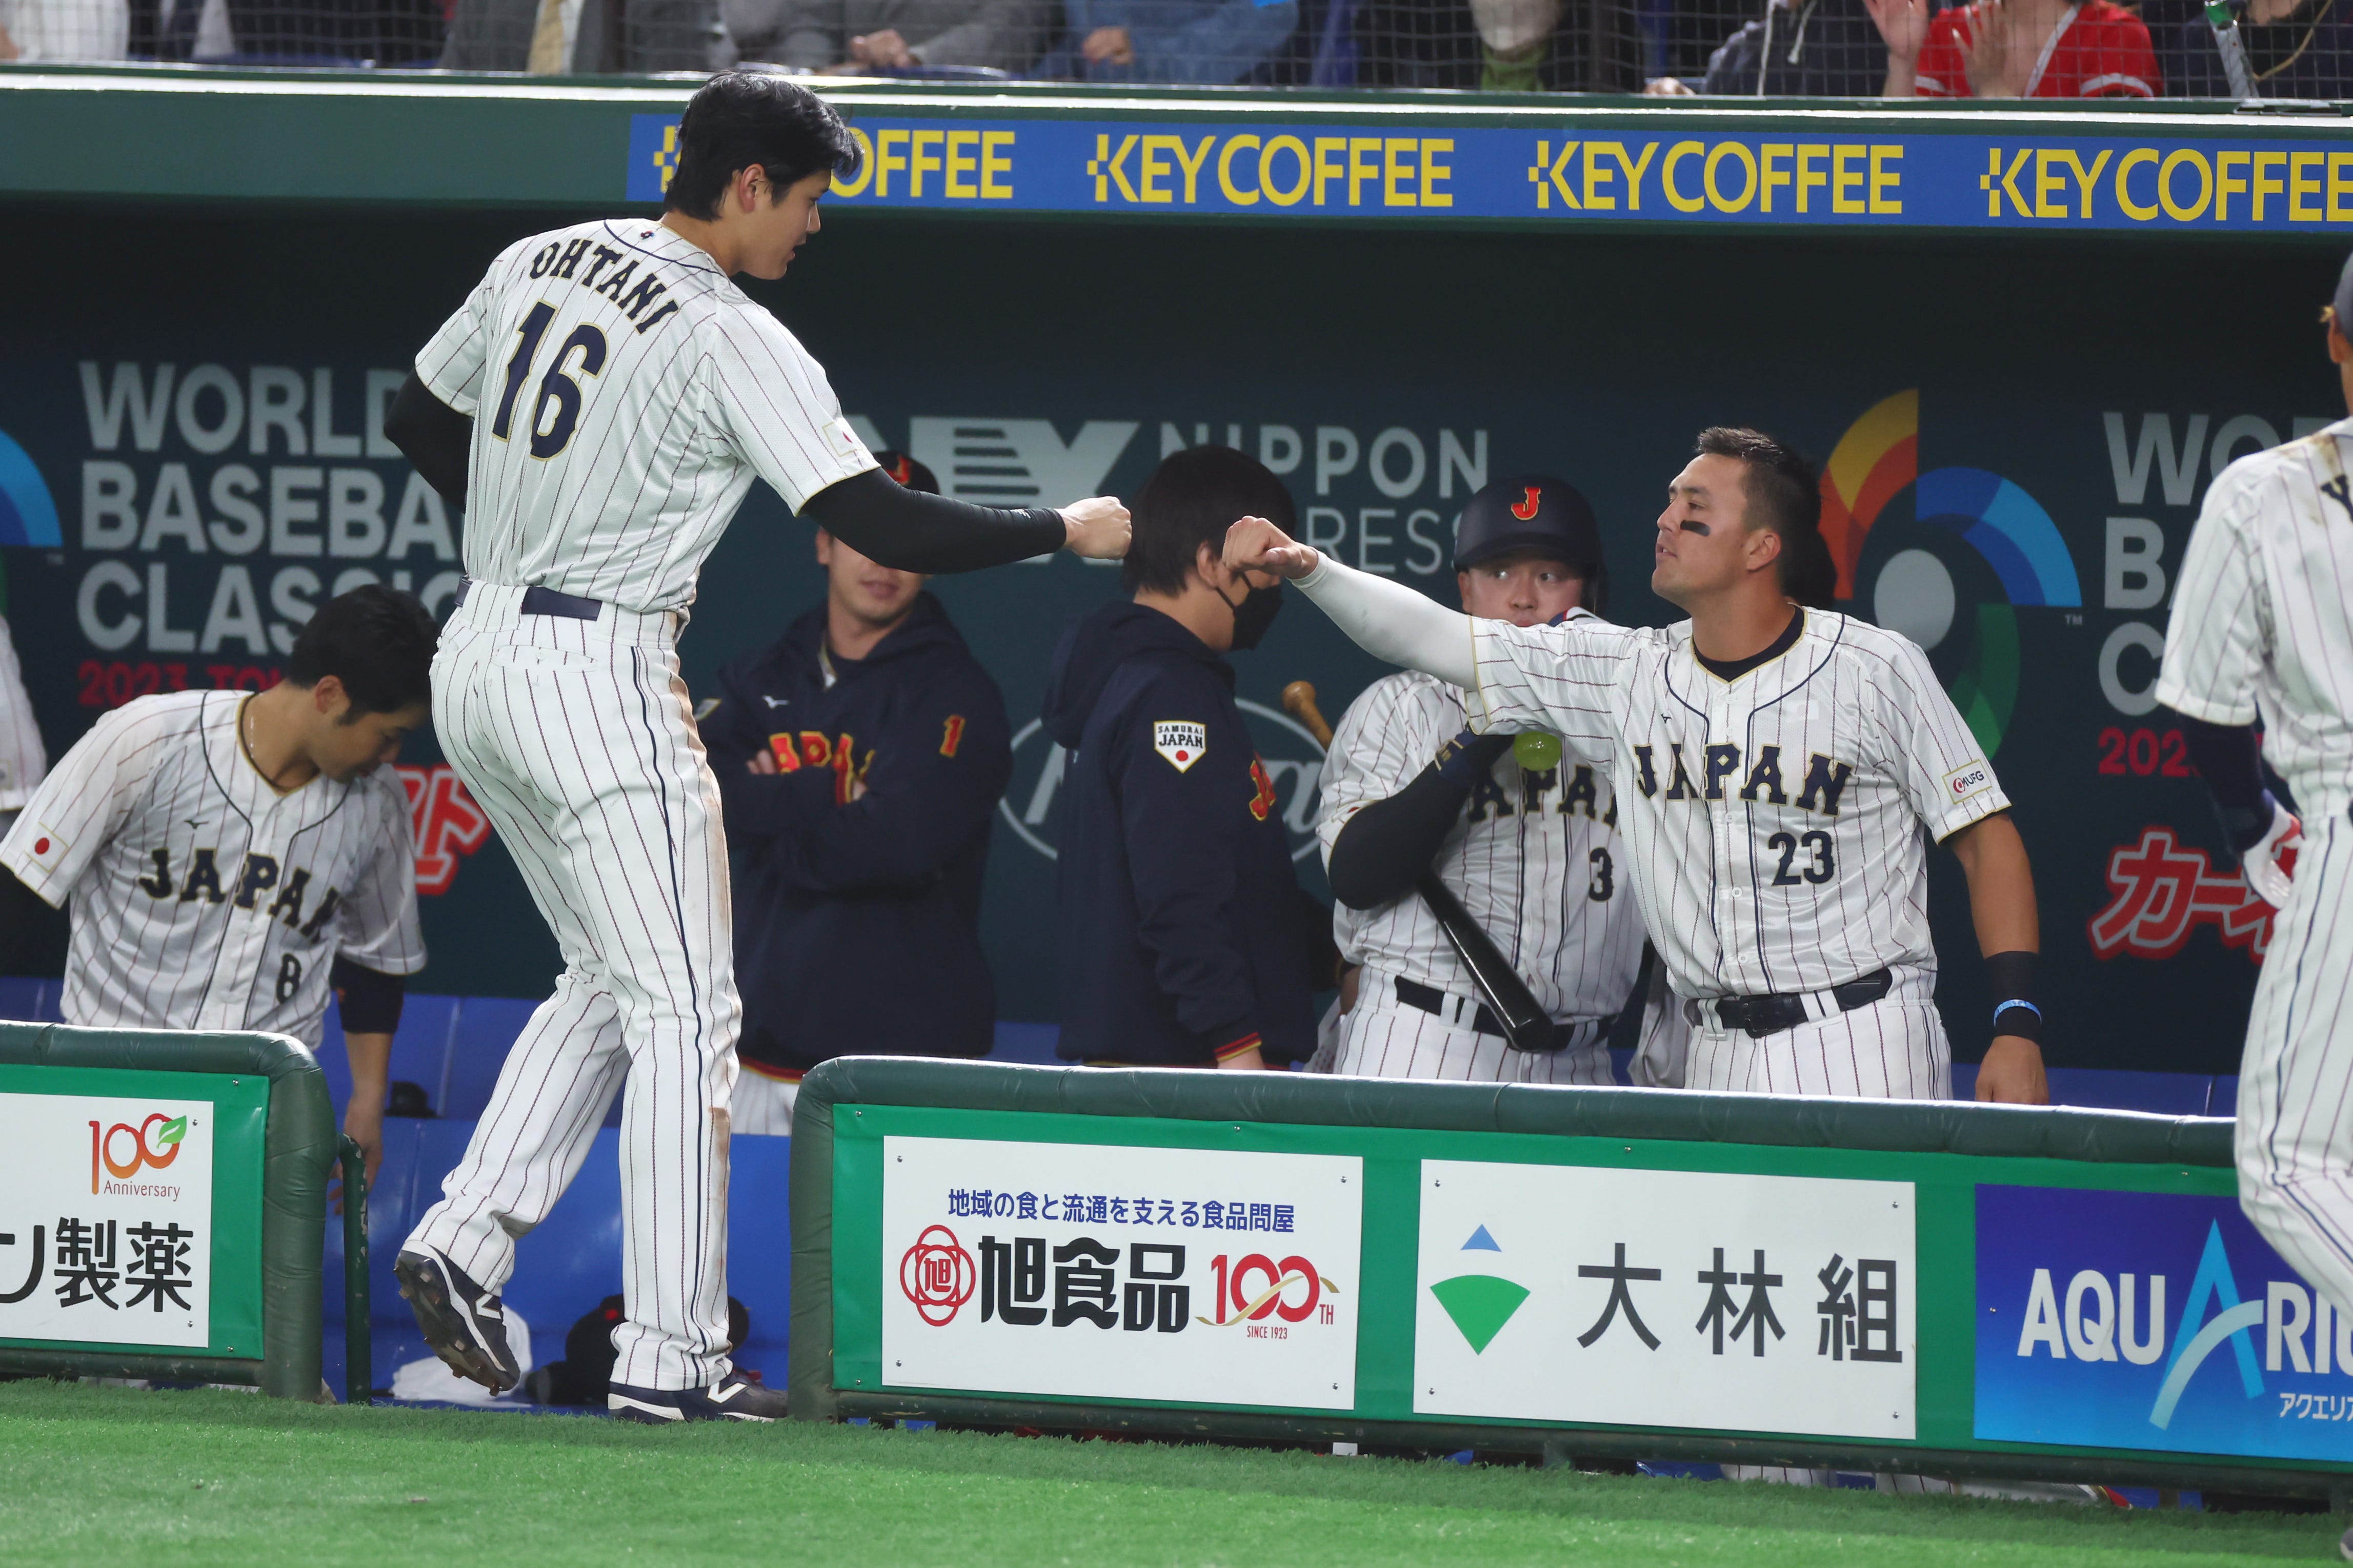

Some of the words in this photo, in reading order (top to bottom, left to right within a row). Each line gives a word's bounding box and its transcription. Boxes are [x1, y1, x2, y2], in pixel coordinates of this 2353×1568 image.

[529, 240, 680, 336] OHTANI
[491, 299, 610, 462] 16
[1511, 486, 1541, 521] J
[939, 714, 966, 758] 1
[1157, 725, 1203, 735] SAMURAI
[1158, 734, 1203, 749] JAPAN
[1633, 742, 1855, 817] JAPAN
[1962, 770, 1984, 787] MUFG
[1590, 846, 1614, 902] 3
[1768, 829, 1836, 887] 23
[276, 952, 302, 1005] 8
[89, 1113, 186, 1195] 100
[104, 1180, 180, 1202] Anniversary
[948, 1188, 1295, 1233] 地域の食と流通を支える食品問屋
[978, 1235, 1190, 1333] 旭食品
[1577, 1243, 1902, 1363] 大林組
[1246, 1325, 1268, 1339] SINCE
[1271, 1326, 1288, 1340] 1923
